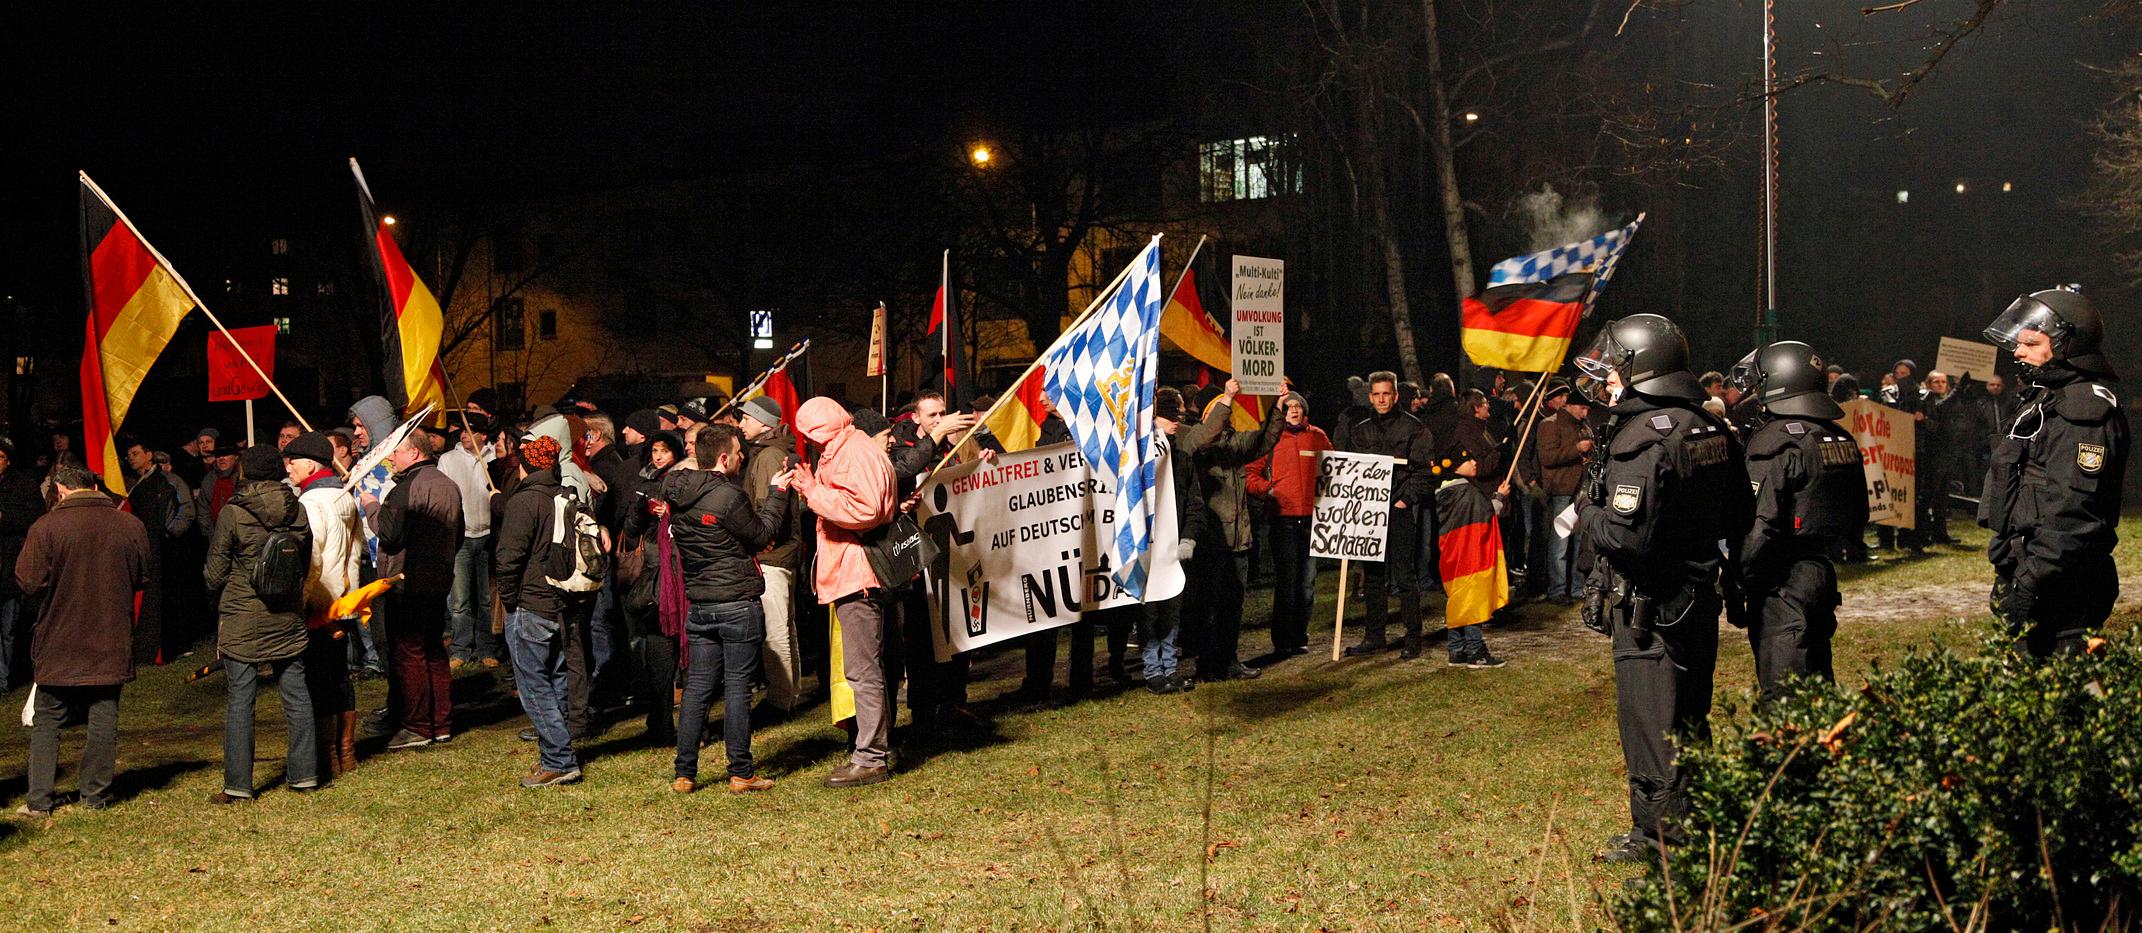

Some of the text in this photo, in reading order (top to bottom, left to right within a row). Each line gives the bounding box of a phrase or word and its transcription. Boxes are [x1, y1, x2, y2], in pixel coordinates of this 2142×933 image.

[1236, 281, 1282, 300] Nein danke!
[1236, 310, 1282, 323] UMVOLKUNG
[1253, 325, 1264, 337] IST
[1238, 336, 1279, 356] VÖLKER-
[1242, 359, 1275, 377] MORD
[951, 459, 1040, 496] GEWALTFREI
[1043, 457, 1056, 474] &
[1321, 456, 1391, 480] 67% der
[1316, 476, 1391, 502] Moslems
[1617, 486, 1638, 495] POLIZEI
[990, 528, 1017, 551] AUF
